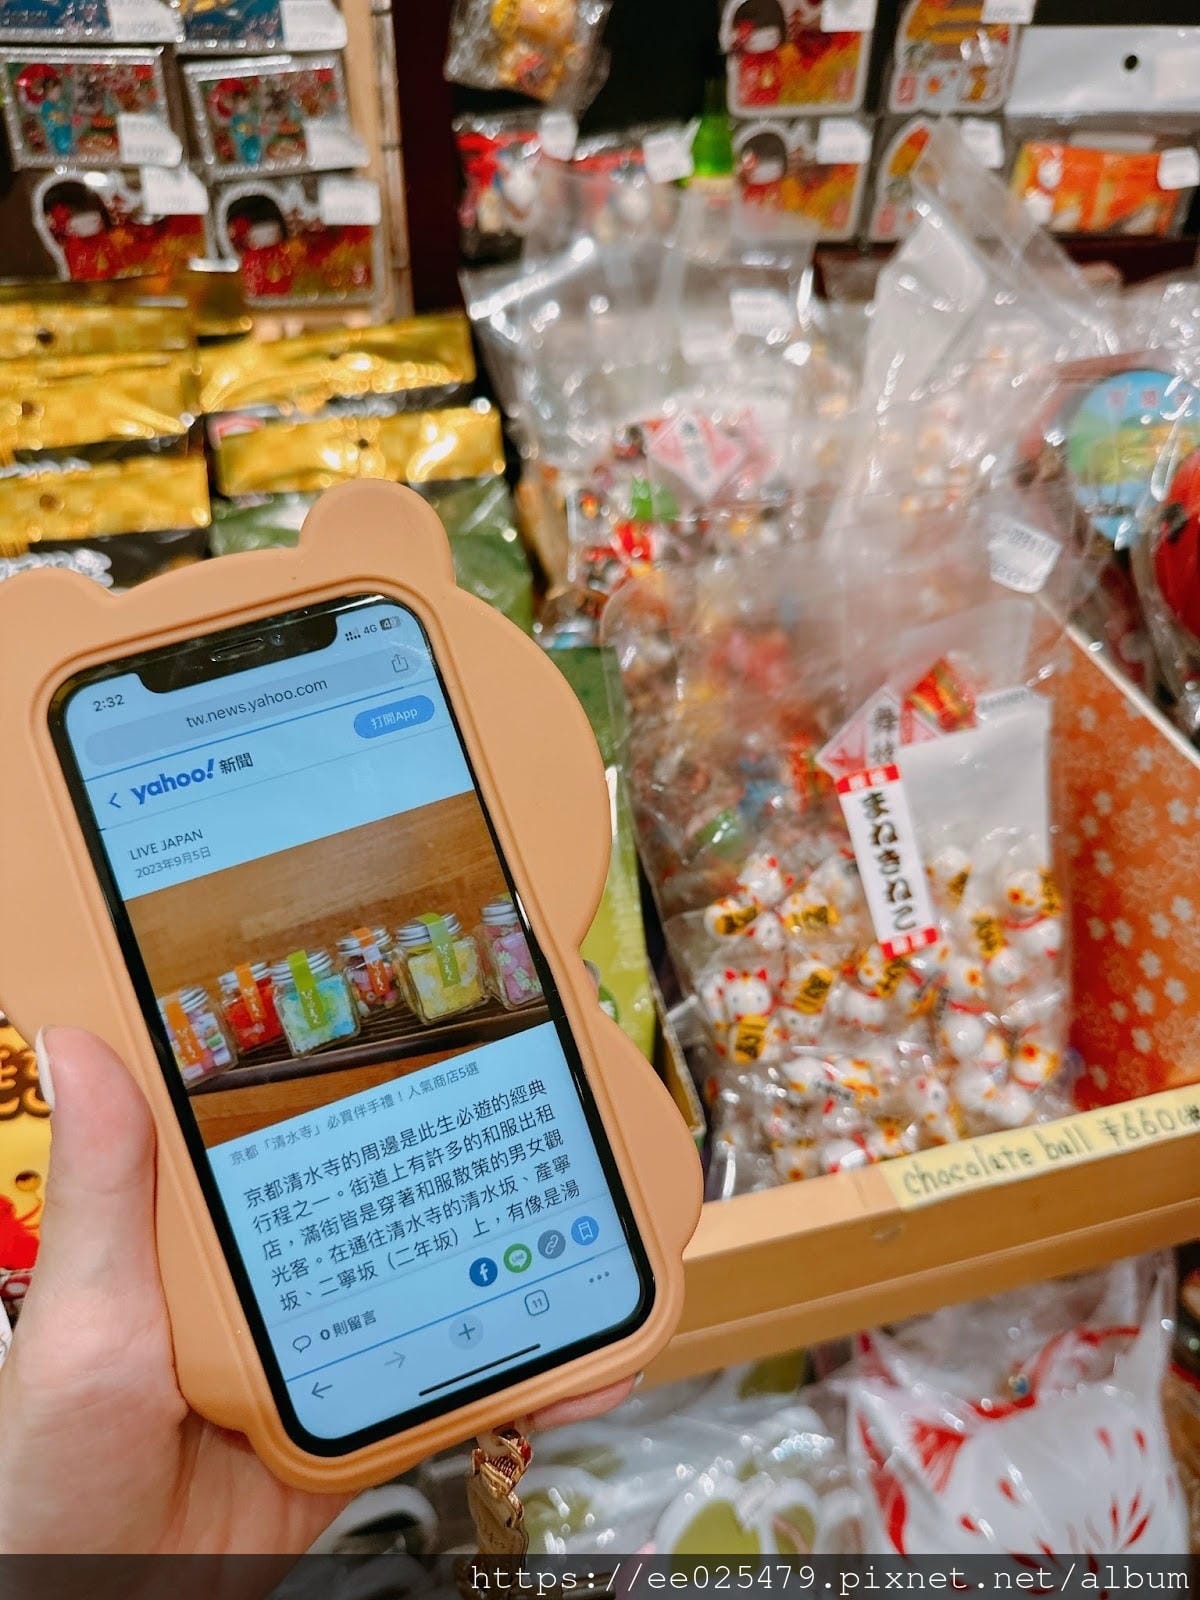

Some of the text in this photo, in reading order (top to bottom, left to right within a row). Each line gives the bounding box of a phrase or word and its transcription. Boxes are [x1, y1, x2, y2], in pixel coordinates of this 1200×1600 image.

[363, 624, 378, 634] 4G
[93, 693, 124, 712] 2:32
[186, 677, 328, 728] tw.news.yahoo.com
[371, 708, 418, 730] 打開App
[130, 752, 254, 805] yahoo! 新聞
[129, 828, 203, 861] LIVE JAPAN
[135, 846, 211, 879] 2023年9月5日
[863, 792, 916, 931] まねきねこ
[244, 1079, 548, 1209] 京都清水寺的周邊是此生必遊的經典
[253, 1103, 556, 1235] 行程之一。街道上有許多的和服出租
[903, 1142, 1034, 1195] chocolate
[1034, 1122, 1094, 1161] ball
[262, 1129, 564, 1261] 店，滿街皆是穿著和服散策的男女觀
[272, 1154, 571, 1287] 光客。在通往清水寺的清水坂、產寧
[281, 1179, 581, 1311] 坂、二寧坂（二年坂）上，有像是湯
[320, 1310, 377, 1340] 0 則留言
